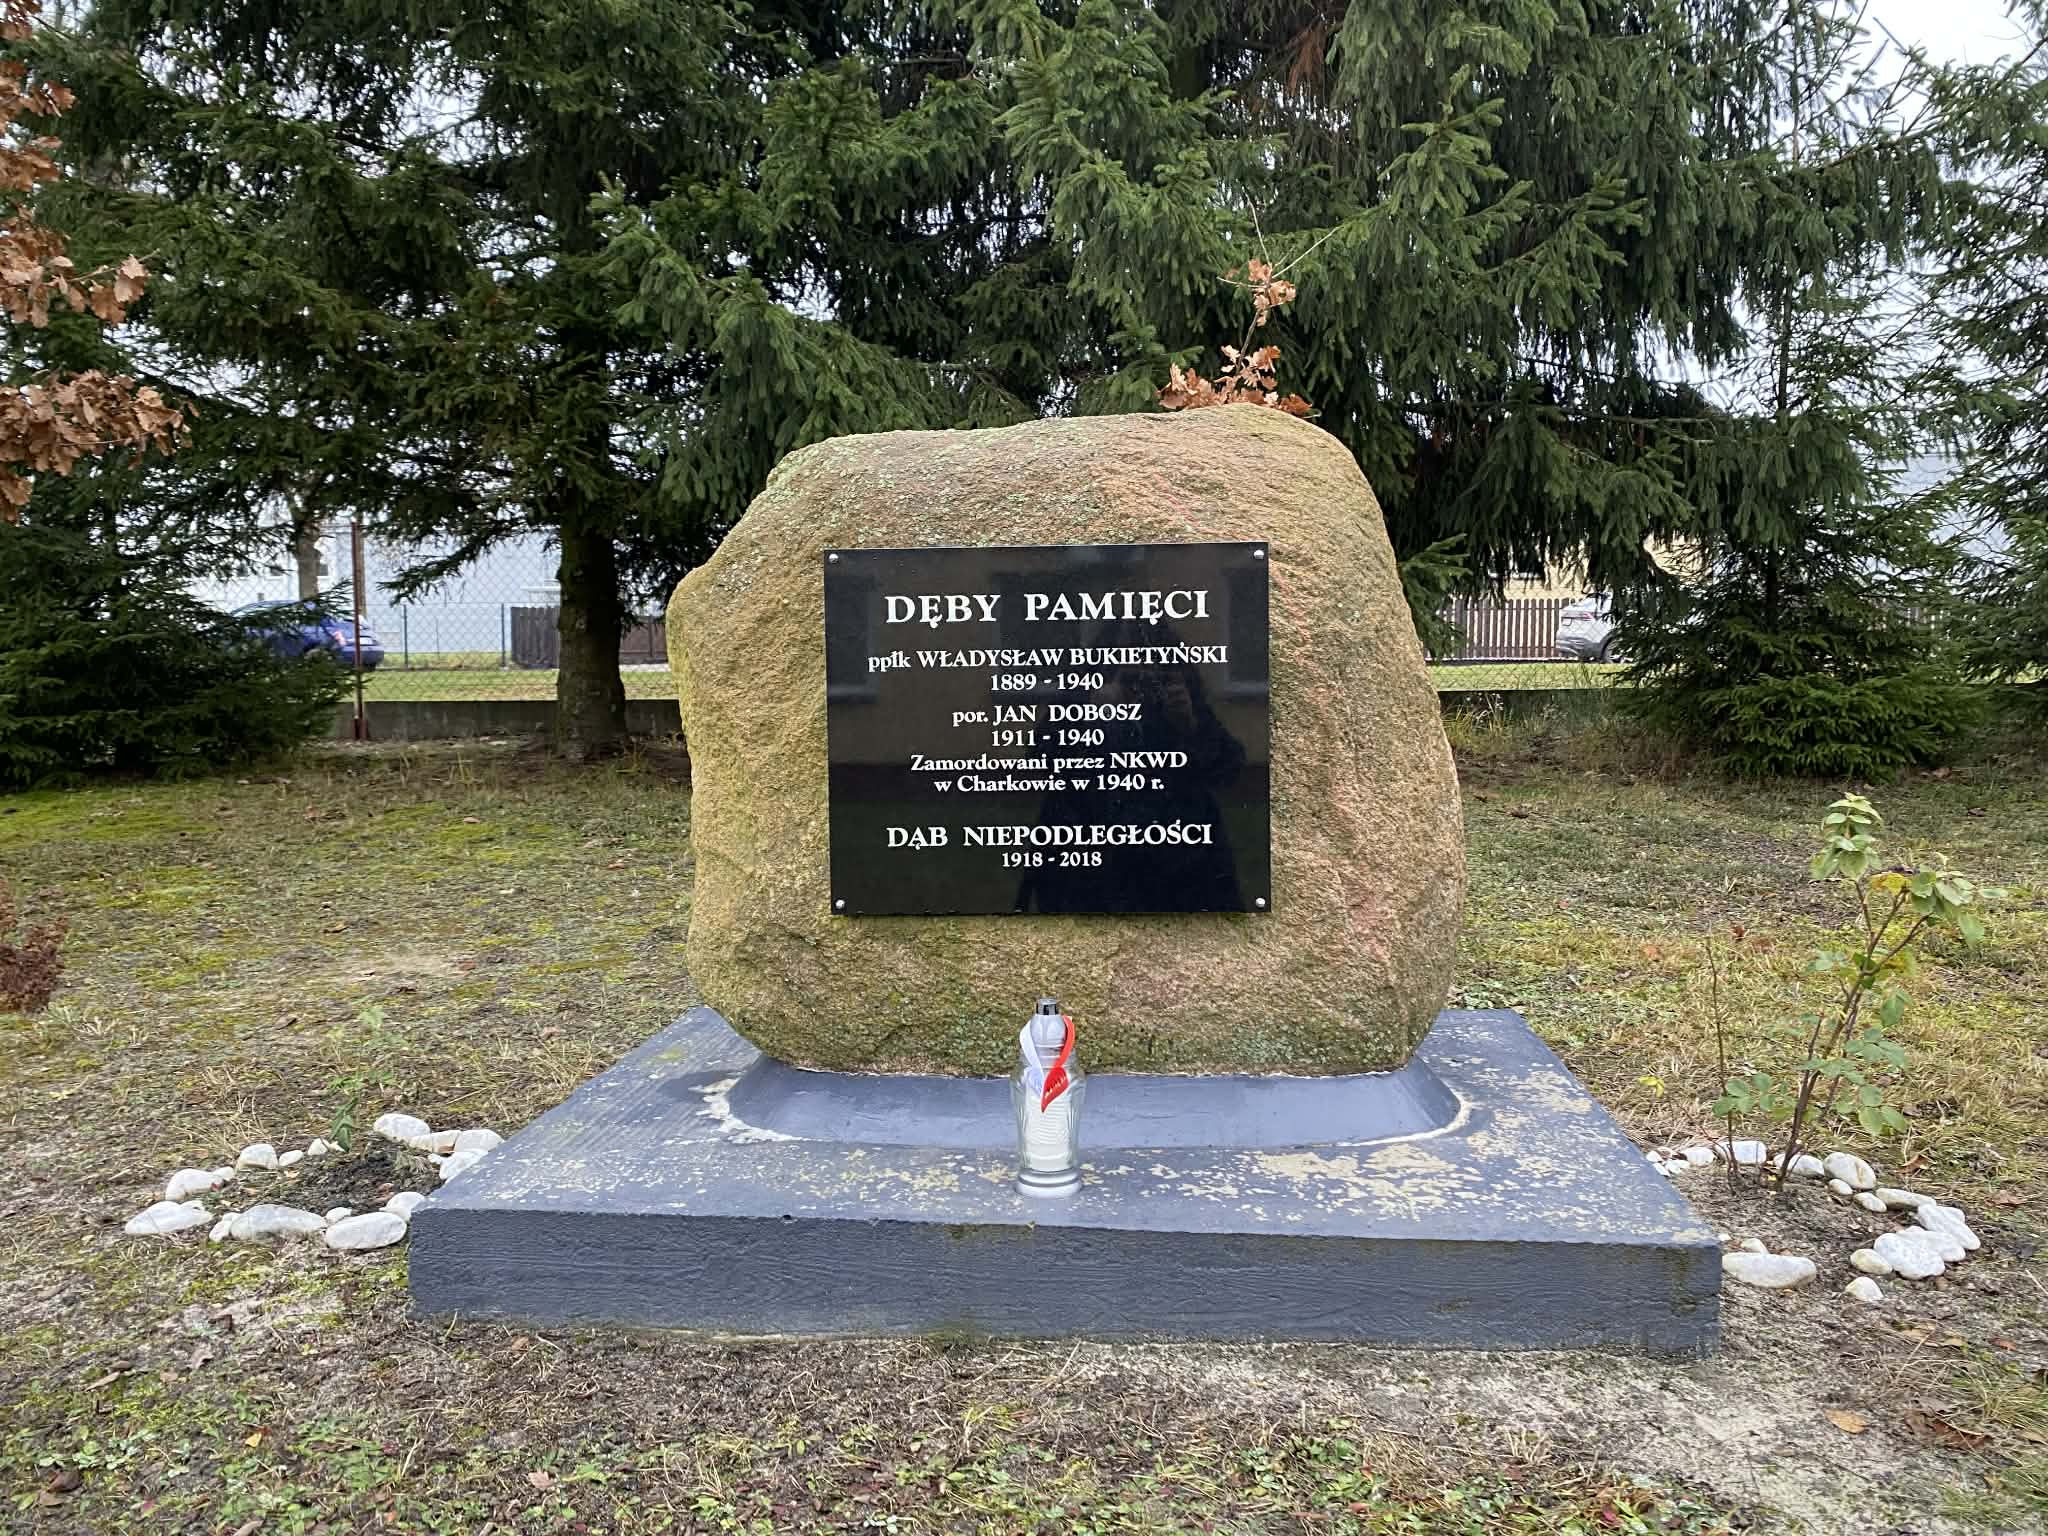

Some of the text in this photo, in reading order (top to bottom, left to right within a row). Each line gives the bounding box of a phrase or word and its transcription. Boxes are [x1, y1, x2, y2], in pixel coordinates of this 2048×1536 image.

[885, 590, 1210, 629] DĘBY PAMIĘCI
[867, 641, 1229, 673] ppłk WŁADYSŁAW BUKIETYŃSKI
[990, 673, 1037, 691] 1889
[1056, 672, 1104, 691] 1940
[952, 703, 1142, 728] por. JAN DOBOSZ
[991, 729, 1037, 747] 1911
[1058, 728, 1105, 747] 1940
[910, 751, 1188, 774] Zamordowani przez NKWD
[933, 773, 1165, 792] w Charkowie w 1940 r.
[886, 819, 1213, 851] DĄB NIEPODLEGŁOŚCI
[1001, 852, 1044, 868] 1918
[1059, 851, 1103, 867] 2018
